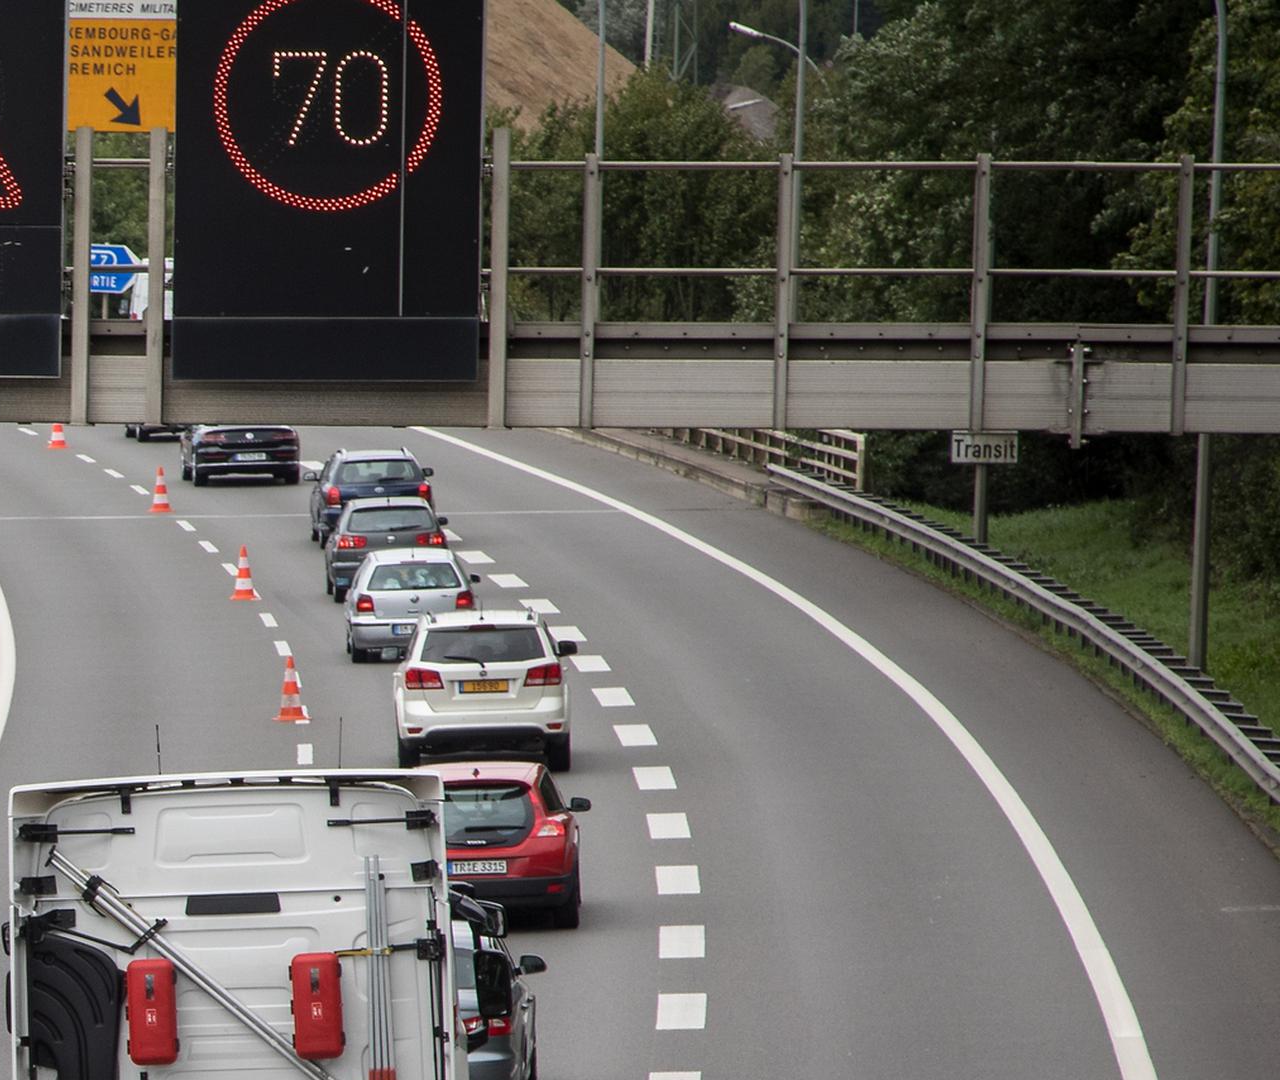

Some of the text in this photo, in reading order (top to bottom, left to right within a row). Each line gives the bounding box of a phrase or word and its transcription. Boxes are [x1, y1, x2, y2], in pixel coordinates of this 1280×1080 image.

[69, 3, 134, 13] CIMETIERES
[71, 45, 176, 58] SANDWEILER
[70, 63, 136, 76] REMICH
[273, 50, 389, 145] 70
[954, 438, 1017, 459] Transit
